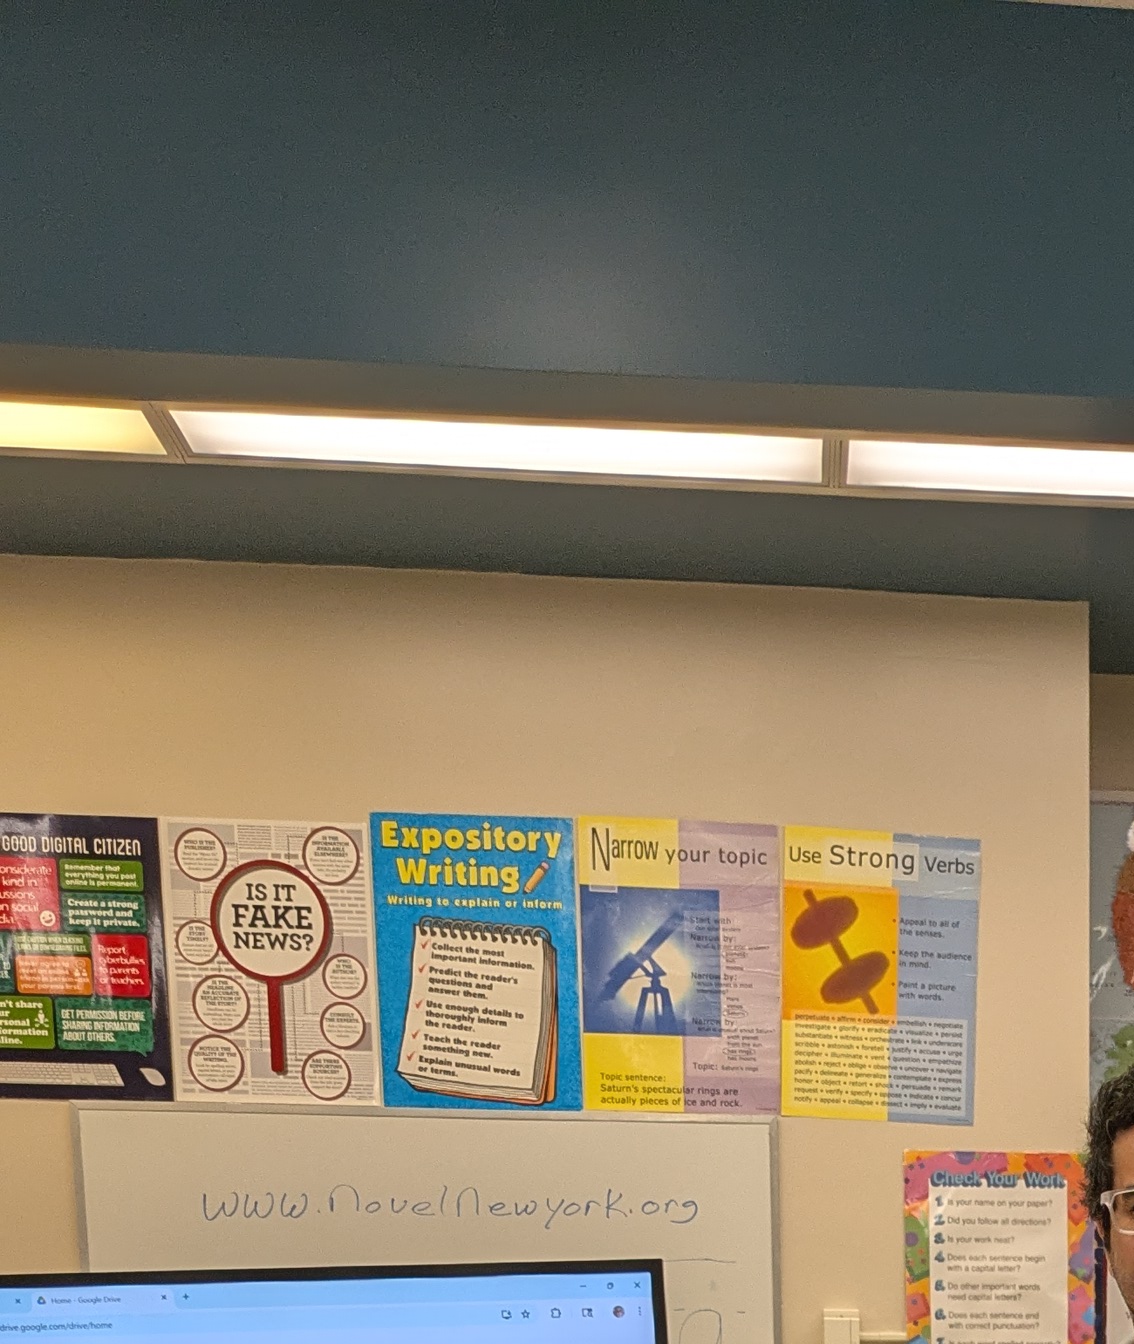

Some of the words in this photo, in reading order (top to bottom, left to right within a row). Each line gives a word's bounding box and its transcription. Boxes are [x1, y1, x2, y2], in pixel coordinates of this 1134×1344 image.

[2, 835, 37, 852] GOOD
[42, 836, 89, 854] DIGITAL
[94, 839, 141, 856] CITIZEN
[381, 821, 562, 859] Expository
[591, 827, 658, 871] Narrow
[665, 849, 710, 865] your
[719, 848, 767, 868] topic
[790, 846, 821, 864] Use
[830, 845, 914, 875] Strong
[925, 856, 974, 875] Verbs
[396, 857, 520, 894] Writing
[246, 883, 267, 900] IS
[274, 884, 296, 901] IT
[67, 899, 97, 907] Create
[108, 901, 138, 910] strong
[388, 895, 432, 907] Writing
[437, 898, 449, 906] to
[455, 898, 500, 908] explain
[505, 900, 518, 908] or
[523, 900, 563, 910] inform
[69, 909, 112, 918] password
[69, 918, 91, 927] keep
[93, 918, 100, 926] it
[102, 919, 140, 927] private.
[232, 904, 313, 930] FAKE
[234, 931, 314, 951] NEWS?
[432, 943, 463, 952] Collect
[467, 945, 479, 953] the
[482, 948, 505, 957] most
[931, 1171, 982, 1187] Check
[985, 1171, 1018, 1188] Your
[1023, 1171, 1066, 1188] Work
